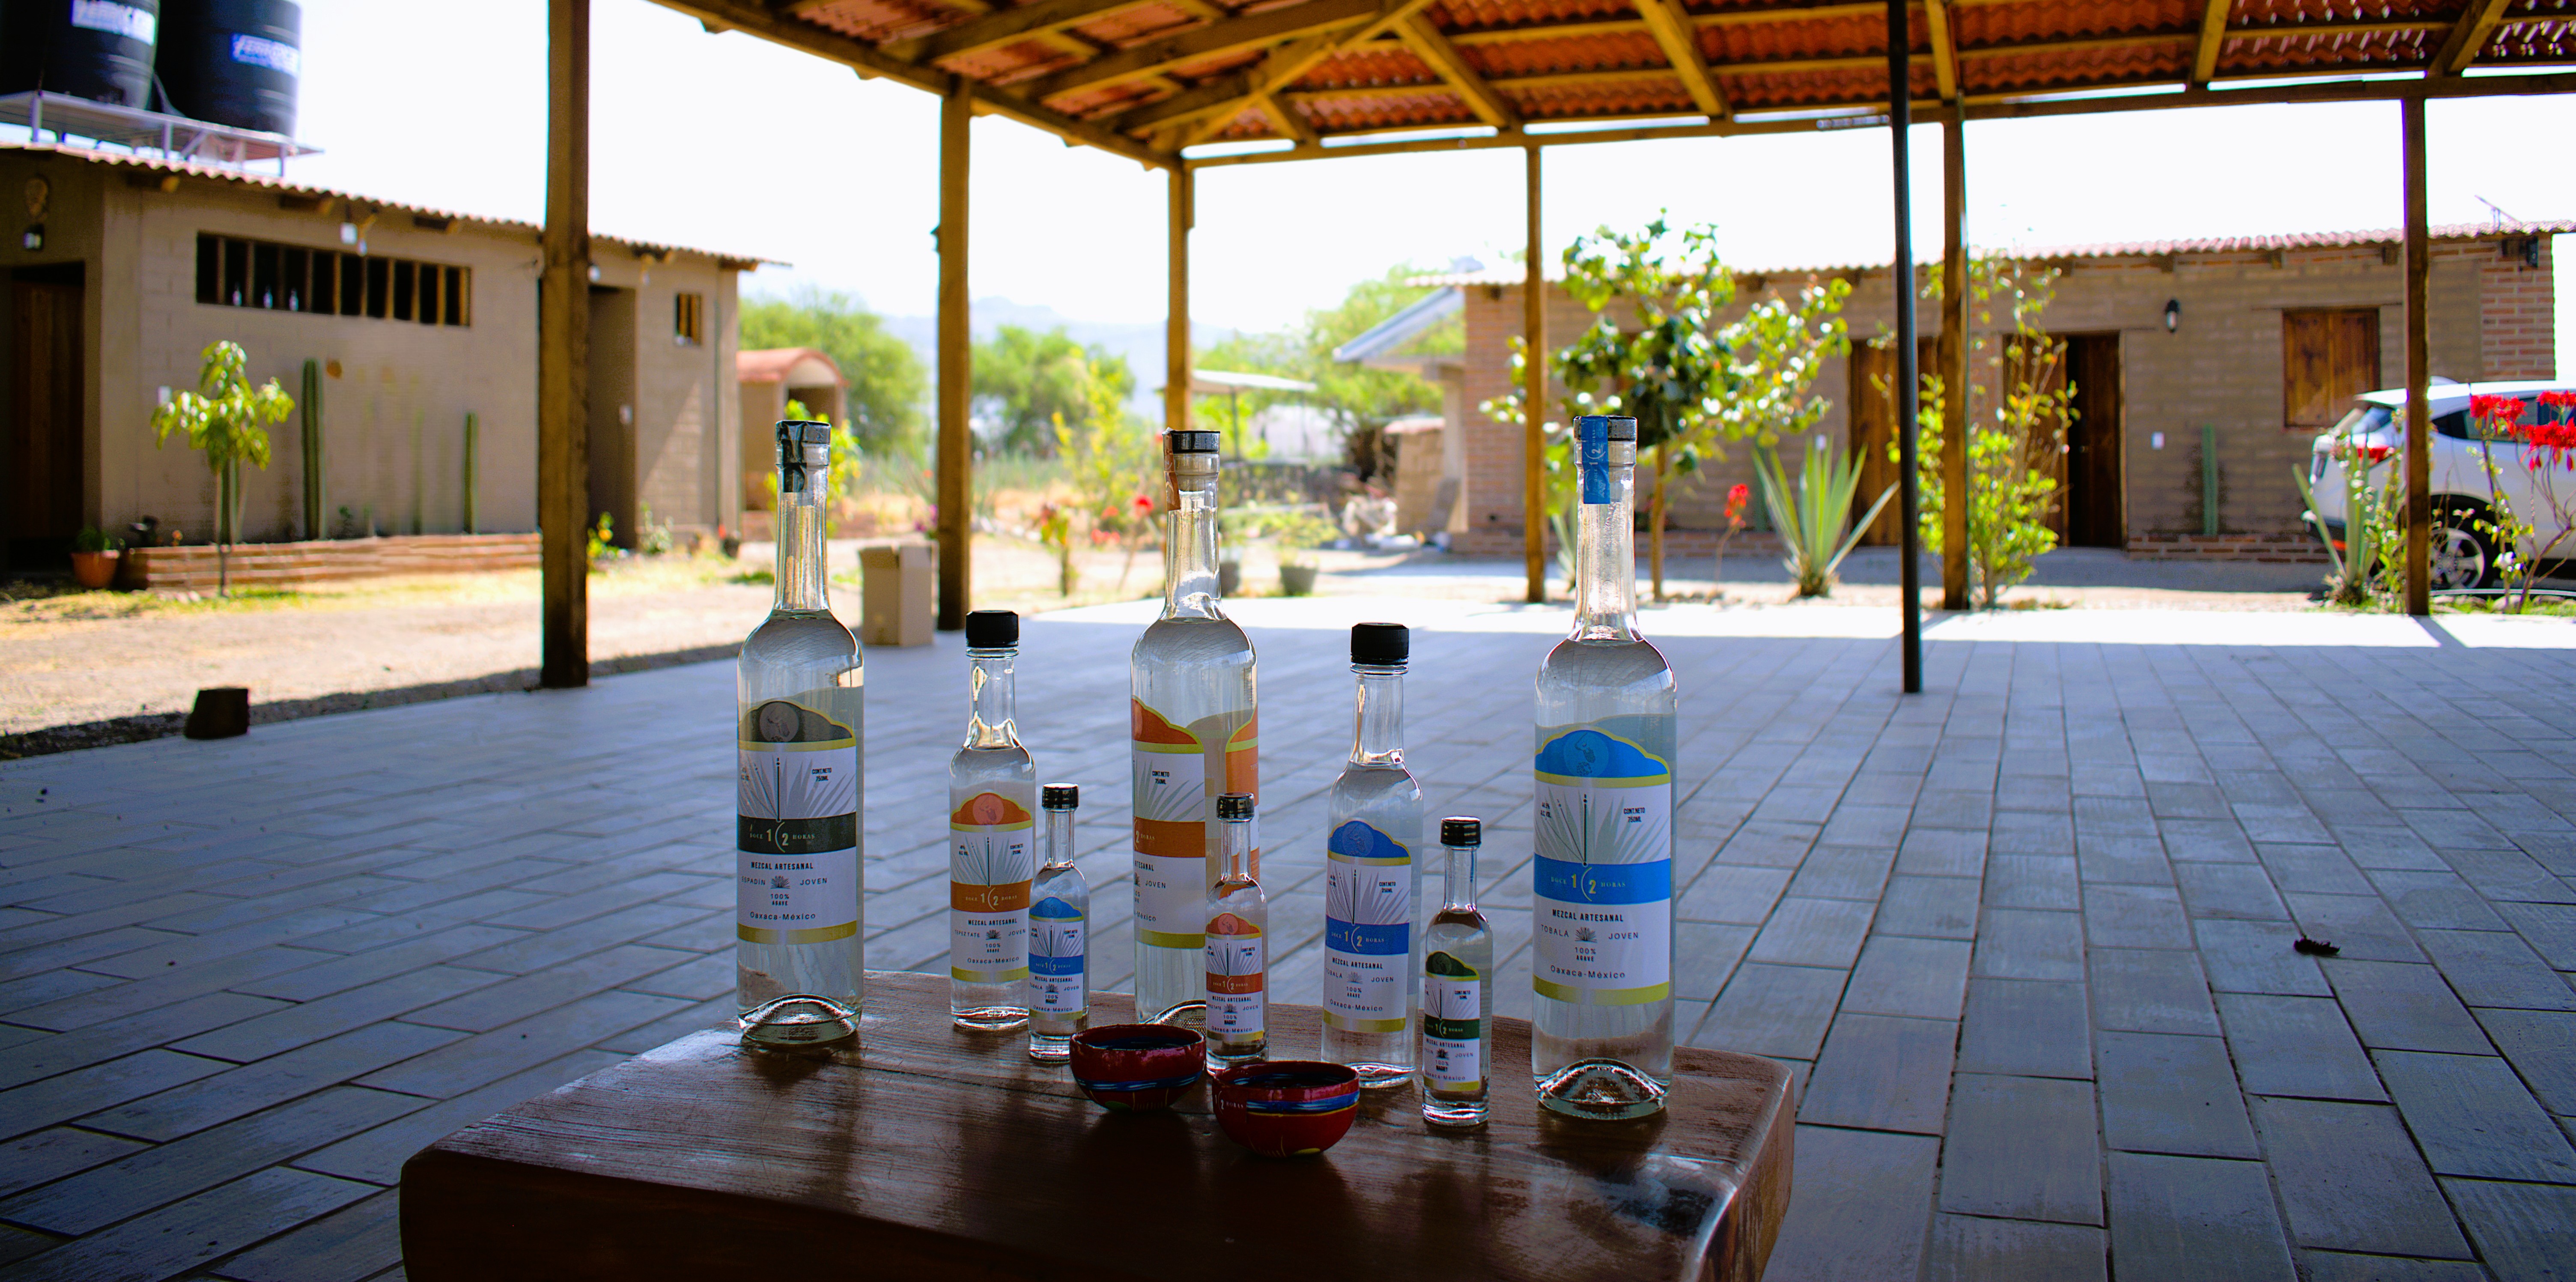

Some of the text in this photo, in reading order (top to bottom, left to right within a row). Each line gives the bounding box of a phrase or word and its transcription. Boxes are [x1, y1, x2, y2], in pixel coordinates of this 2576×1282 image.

[751, 861, 772, 870] MEZCAL
[1145, 880, 1166, 888] JOVEN
[1552, 908, 1624, 922] MEZCAL ARTESANAL
[1008, 928, 1026, 936] JOVEN
[1332, 957, 1383, 969] MEZCAL ARTESANAL
